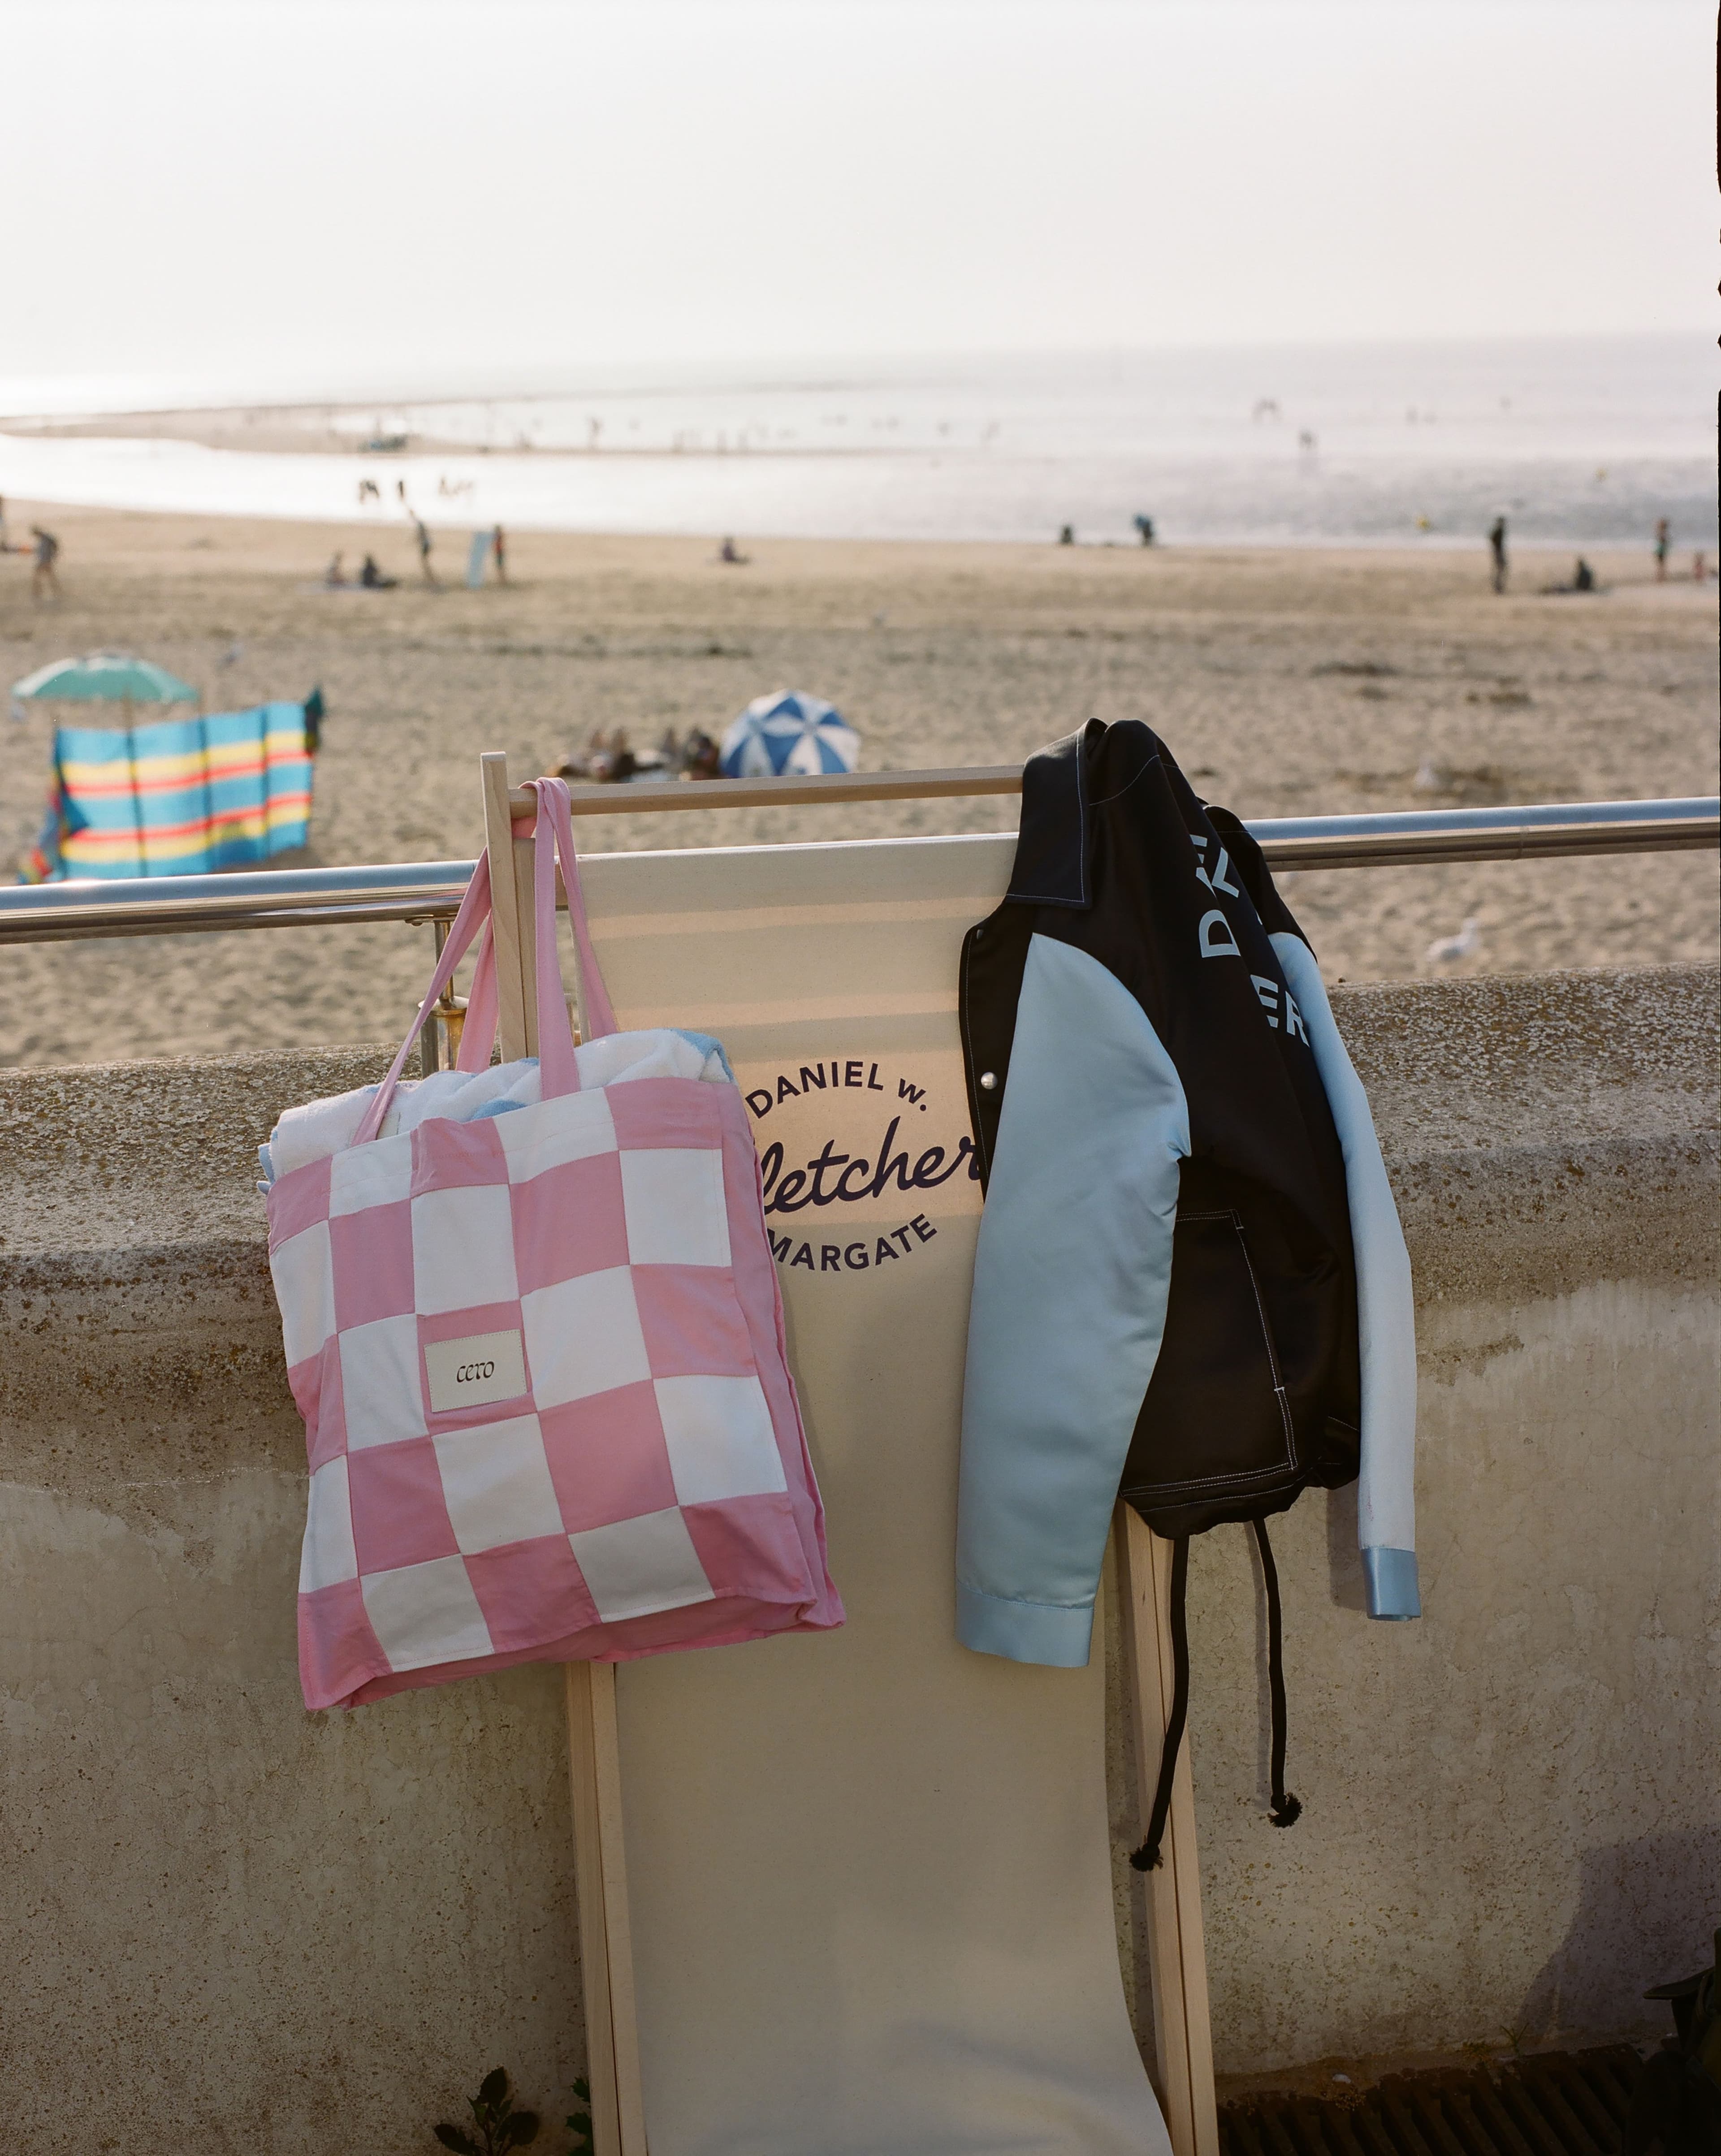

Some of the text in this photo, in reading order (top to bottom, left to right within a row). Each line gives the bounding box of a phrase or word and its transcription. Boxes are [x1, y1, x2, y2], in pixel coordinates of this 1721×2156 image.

[745, 1060, 884, 1119] DANIEL
[761, 1115, 981, 1215] letcher
[767, 1213, 938, 1271] MARGATE
[456, 1361, 495, 1383] cero
